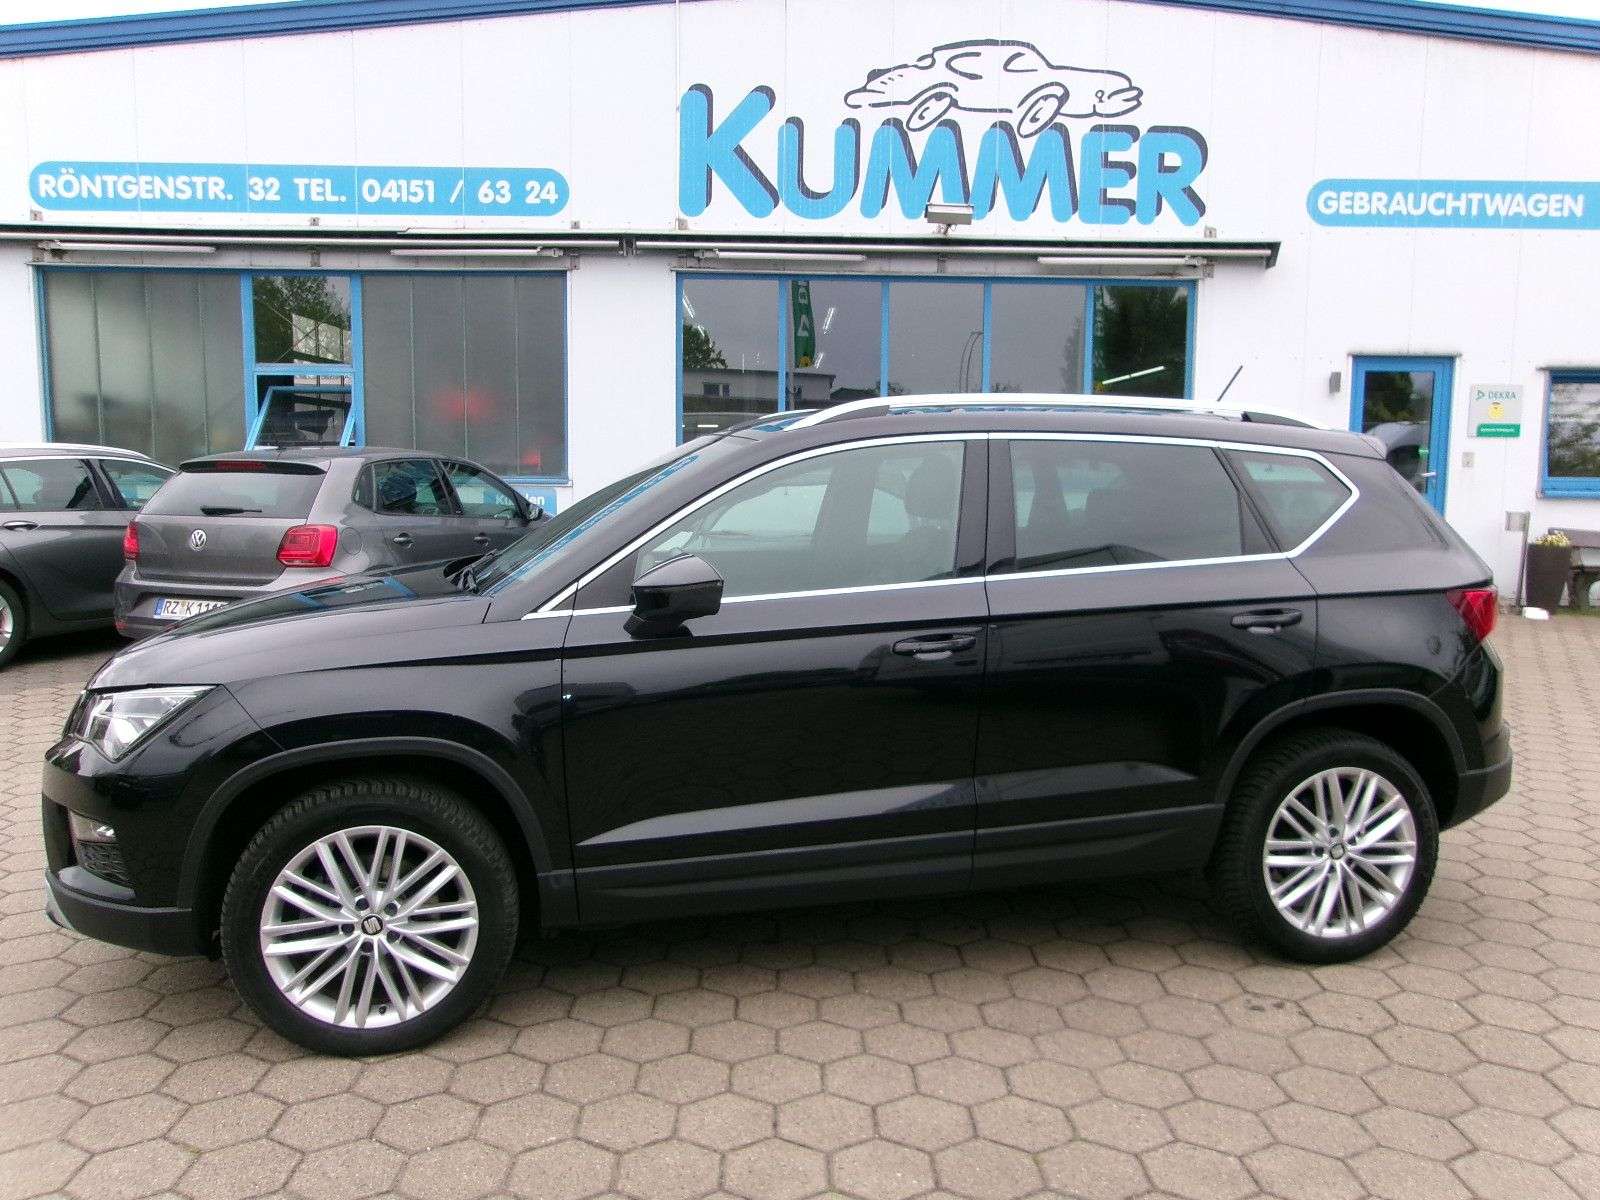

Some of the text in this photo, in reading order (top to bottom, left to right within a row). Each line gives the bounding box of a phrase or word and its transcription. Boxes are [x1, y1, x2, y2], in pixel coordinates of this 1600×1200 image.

[679, 83, 1209, 226] KUMMER
[38, 168, 559, 204] RÖNTGENSTR. 32 TEL. 04151 / 63 24
[1317, 190, 1584, 218] GEBRAUCHTWAGEN
[163, 600, 180, 615] RZ
[185, 601, 195, 616] K
